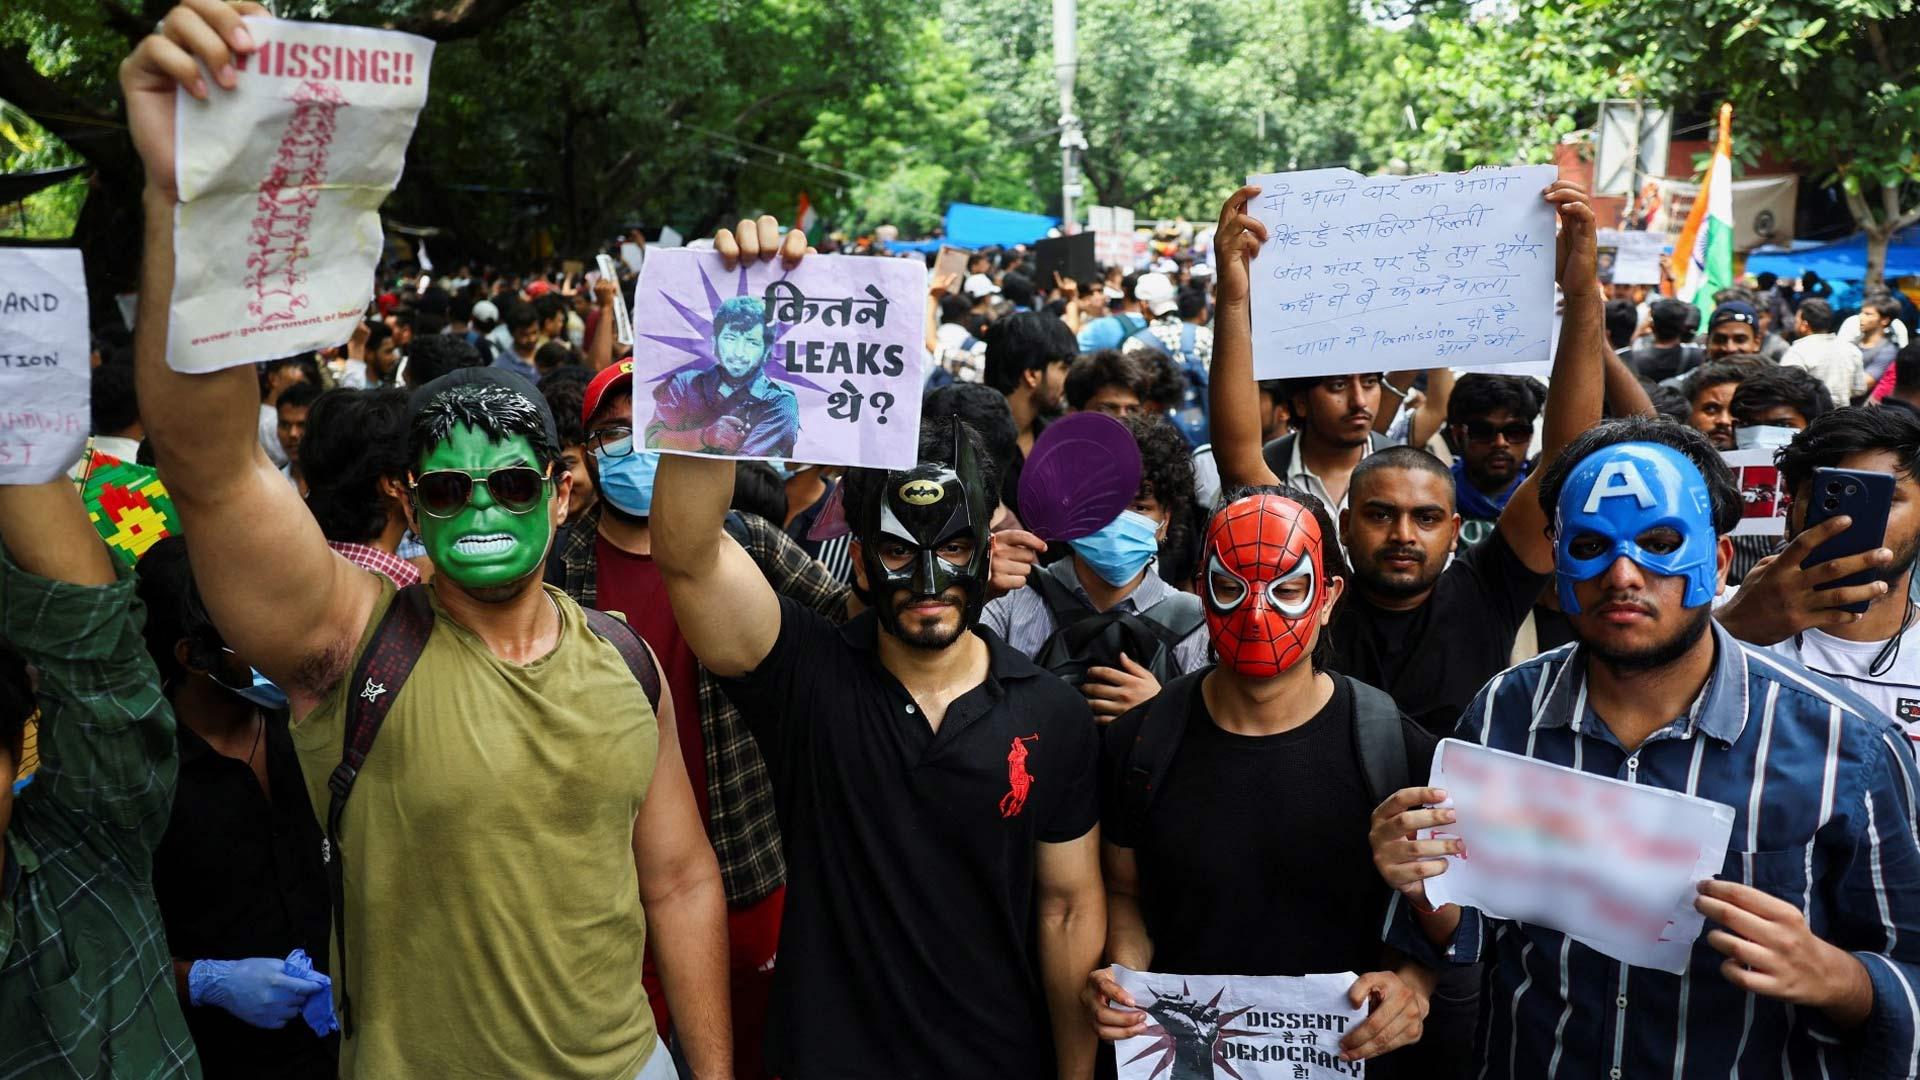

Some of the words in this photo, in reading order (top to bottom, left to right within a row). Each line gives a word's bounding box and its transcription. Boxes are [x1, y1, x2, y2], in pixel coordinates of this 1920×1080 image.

[234, 41, 414, 86] MISSING!!
[0, 291, 60, 315] AND
[762, 280, 890, 329] कितने
[785, 340, 905, 377] LEAKS
[1583, 461, 1658, 513] A
[1246, 1011, 1350, 1034] DISSENT
[1282, 1031, 1296, 1044] है
[1221, 1040, 1362, 1078] DEMOCRACY
